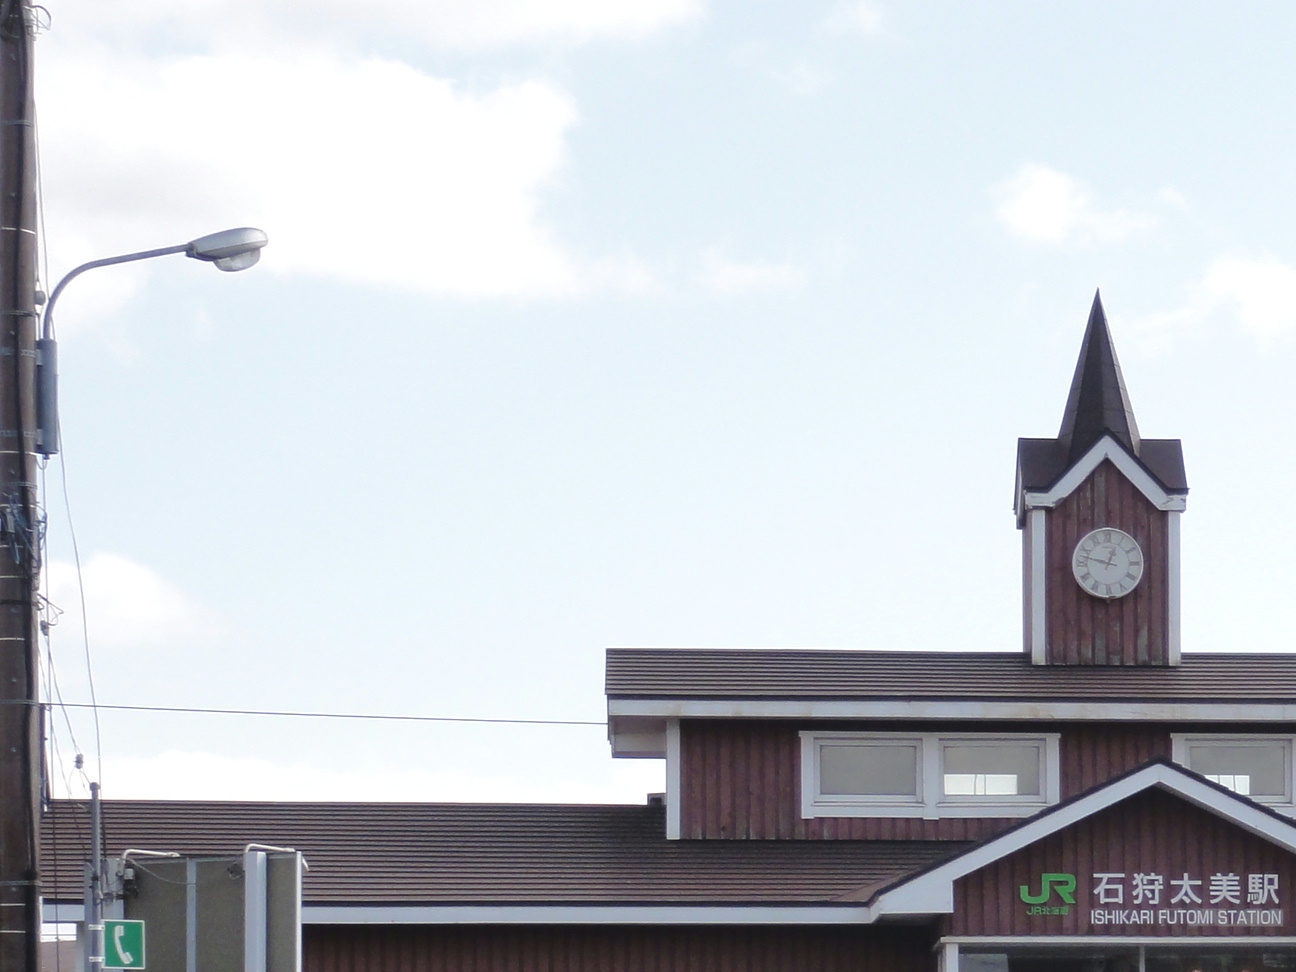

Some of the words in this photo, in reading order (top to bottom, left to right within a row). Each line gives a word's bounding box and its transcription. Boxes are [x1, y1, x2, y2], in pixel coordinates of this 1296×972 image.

[1019, 873, 1077, 904] JR
[1092, 872, 1280, 905] 石狩太美駅
[1091, 909, 1154, 925] ISHIKARI
[1158, 909, 1213, 925] FUTOMI
[1217, 909, 1283, 925] STATION
